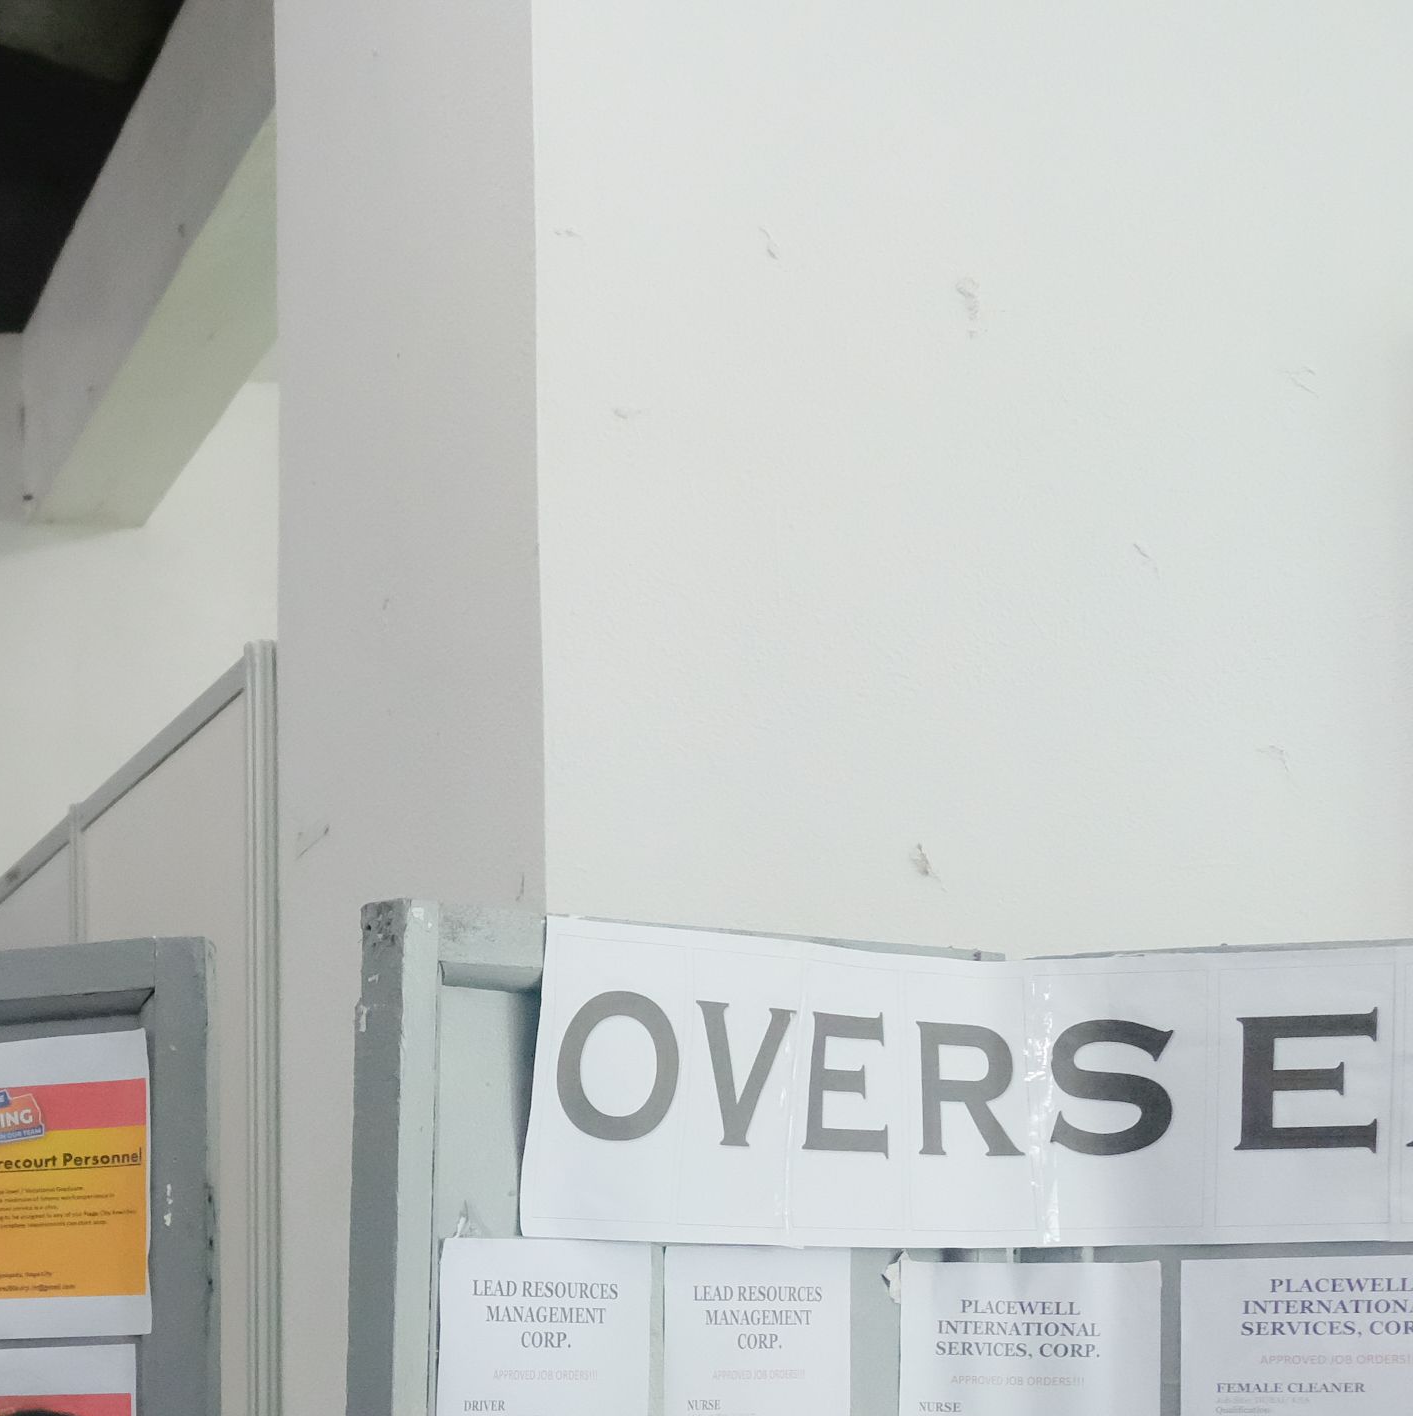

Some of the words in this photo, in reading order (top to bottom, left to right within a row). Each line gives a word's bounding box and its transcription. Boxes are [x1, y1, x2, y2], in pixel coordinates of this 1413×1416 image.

[557, 990, 1413, 1157] OVERSE
[63, 1147, 142, 1166] Personnel
[473, 1280, 517, 1297] LEAD
[522, 1281, 618, 1300] RESOURCES
[1270, 1278, 1413, 1292] PLACEWELL
[693, 1286, 733, 1301] LEAD
[737, 1286, 822, 1302] RESOURCES
[486, 1306, 606, 1324] MANAGEMENT
[961, 1300, 1081, 1316] PLACEWELL
[705, 1310, 811, 1326] MANAGEMENT
[938, 1320, 1101, 1337] INTERNATIONAL
[521, 1331, 571, 1349] CORP.
[737, 1333, 782, 1349] CORP.
[935, 1340, 1034, 1360] SERVICES,
[1039, 1343, 1100, 1359] CORP.
[1216, 1383, 1283, 1393] FEMALE
[1287, 1383, 1365, 1393] CLEANER
[464, 1400, 505, 1412] DRIVER
[688, 1399, 721, 1410] NURSE
[919, 1402, 962, 1413] NURSE
